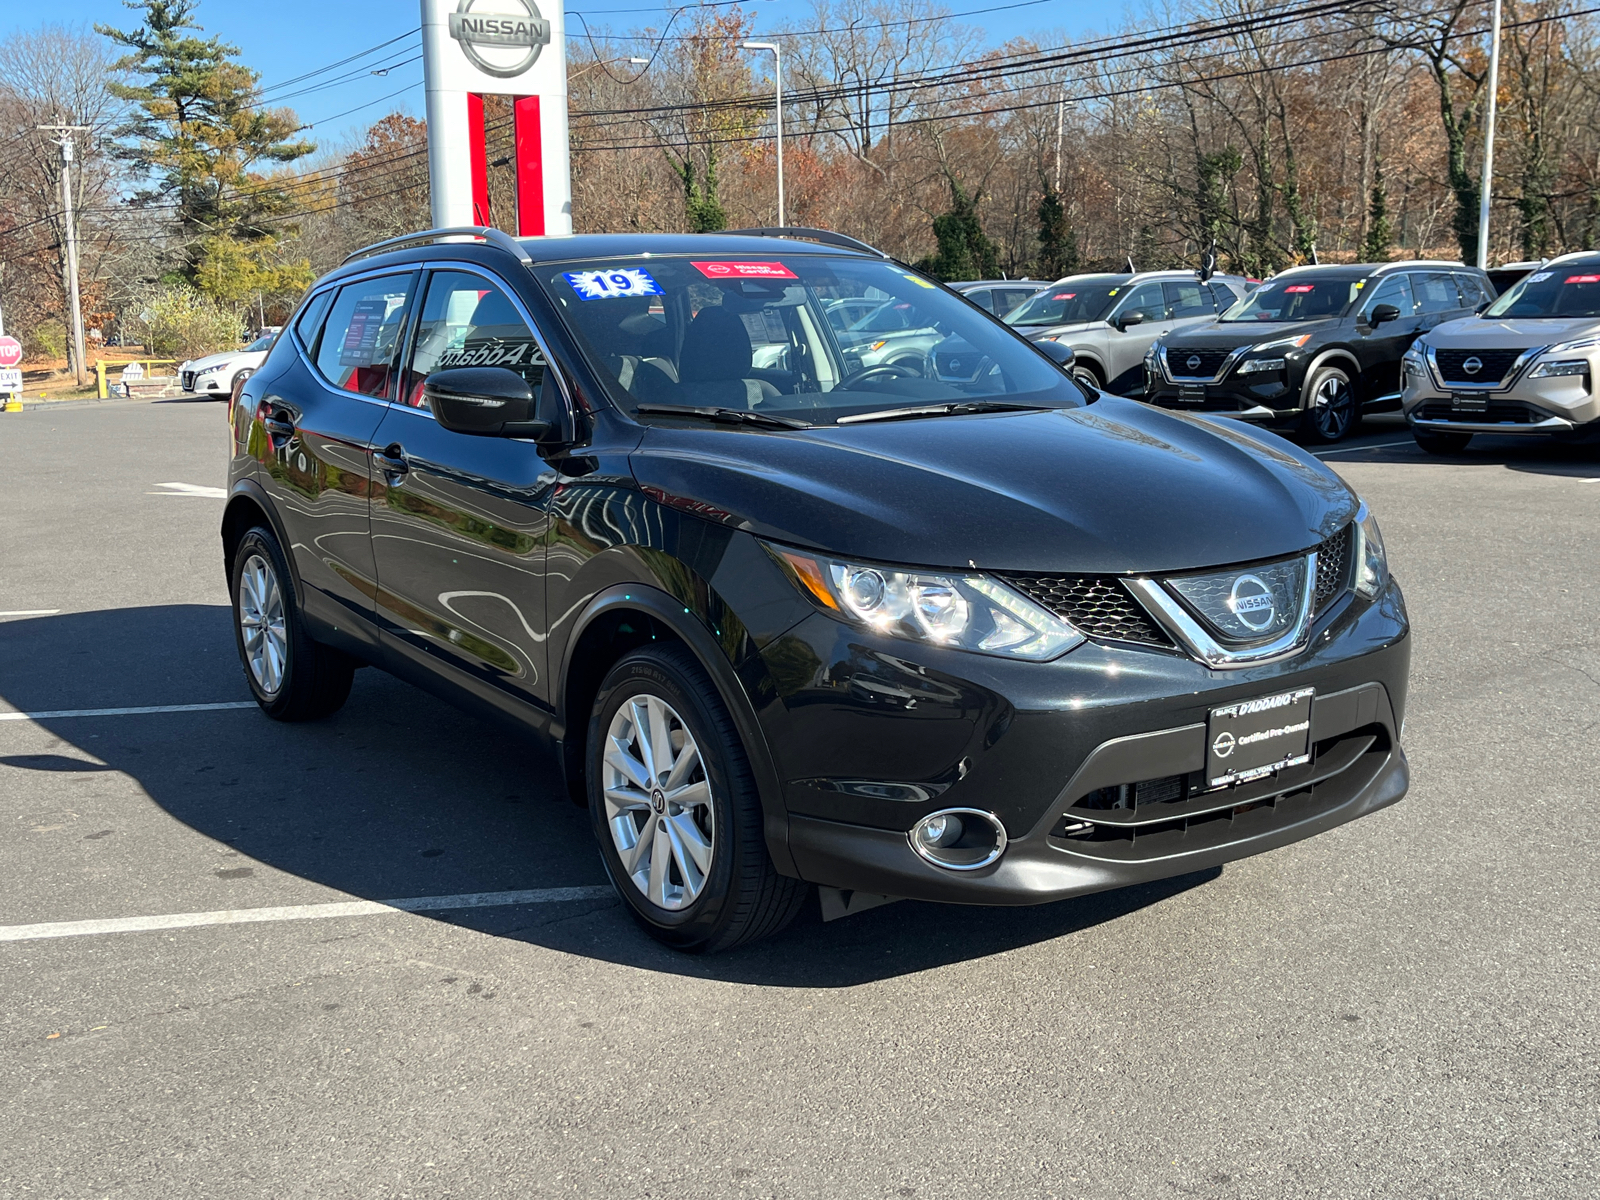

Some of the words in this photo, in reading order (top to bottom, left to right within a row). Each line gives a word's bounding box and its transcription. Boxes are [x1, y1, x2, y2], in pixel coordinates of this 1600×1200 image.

[461, 18, 543, 37] NISSAN
[591, 274, 632, 291] 19
[0, 344, 19, 357] TOP
[0, 372, 18, 380] EXIT
[1236, 596, 1274, 610] NISSAN
[1239, 694, 1291, 715] D'ADDARIO
[1294, 687, 1314, 698] GMC
[1238, 730, 1270, 745] Certified
[1270, 720, 1310, 738] Pre-Owned
[1213, 740, 1236, 750] NISSAN
[1274, 761, 1286, 771] CT
